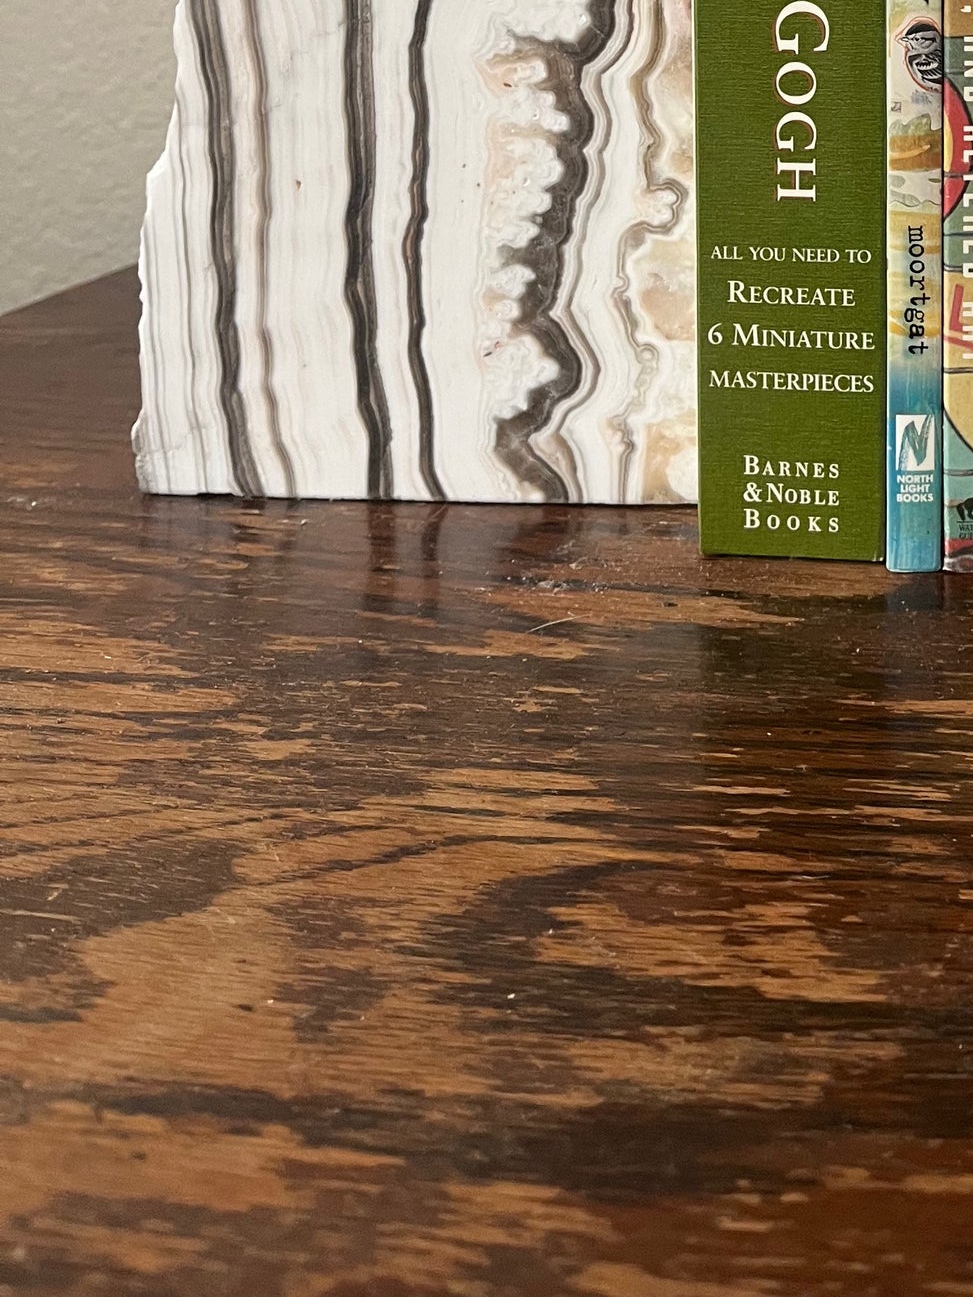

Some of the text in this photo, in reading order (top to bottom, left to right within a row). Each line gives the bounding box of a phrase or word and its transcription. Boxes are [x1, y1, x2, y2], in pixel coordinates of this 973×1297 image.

[772, 0, 830, 202] GOGH
[711, 245, 872, 264] ALL YOU NEED TO
[727, 280, 856, 307] RECREATE
[904, 225, 931, 355] moortgat
[707, 322, 876, 350] 6 MINIATURE
[709, 370, 875, 394] MASTERPIECES
[743, 454, 840, 479] BARNES
[896, 474, 934, 484] NORTH
[896, 493, 934, 503] BOOKS
[900, 484, 930, 494] LIGHT
[743, 508, 840, 534] BOOKS
